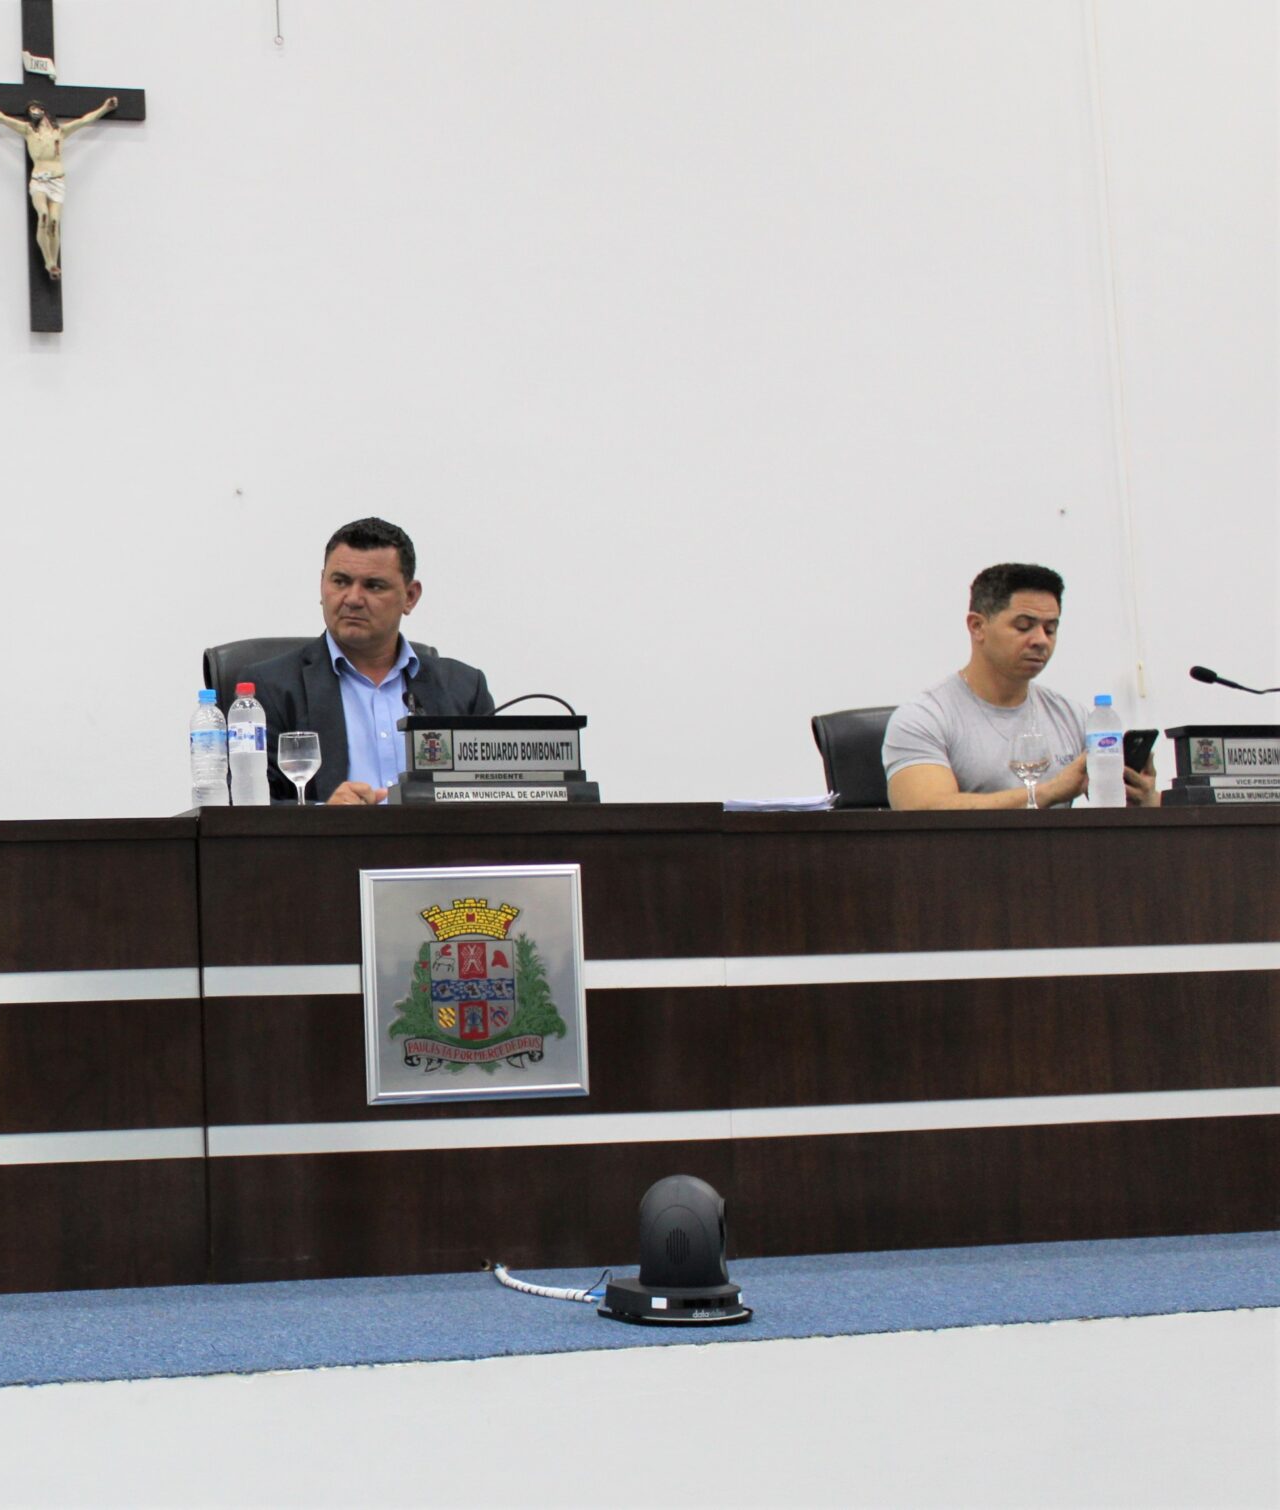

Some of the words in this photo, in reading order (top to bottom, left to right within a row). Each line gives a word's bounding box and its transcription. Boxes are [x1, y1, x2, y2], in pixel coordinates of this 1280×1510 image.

[457, 738, 478, 761] JOSÉ
[480, 742, 519, 761] EDUARDO
[521, 741, 573, 761] BOMBONATTI
[1227, 747, 1257, 765] MARCOS
[435, 788, 470, 800] CÂMARA
[472, 790, 515, 799] MUNICIPAL
[517, 790, 529, 799] DE
[530, 789, 567, 799] CAPIVARI
[1246, 791, 1280, 799] MUNICIPA
[407, 1040, 451, 1059] PAULISTA
